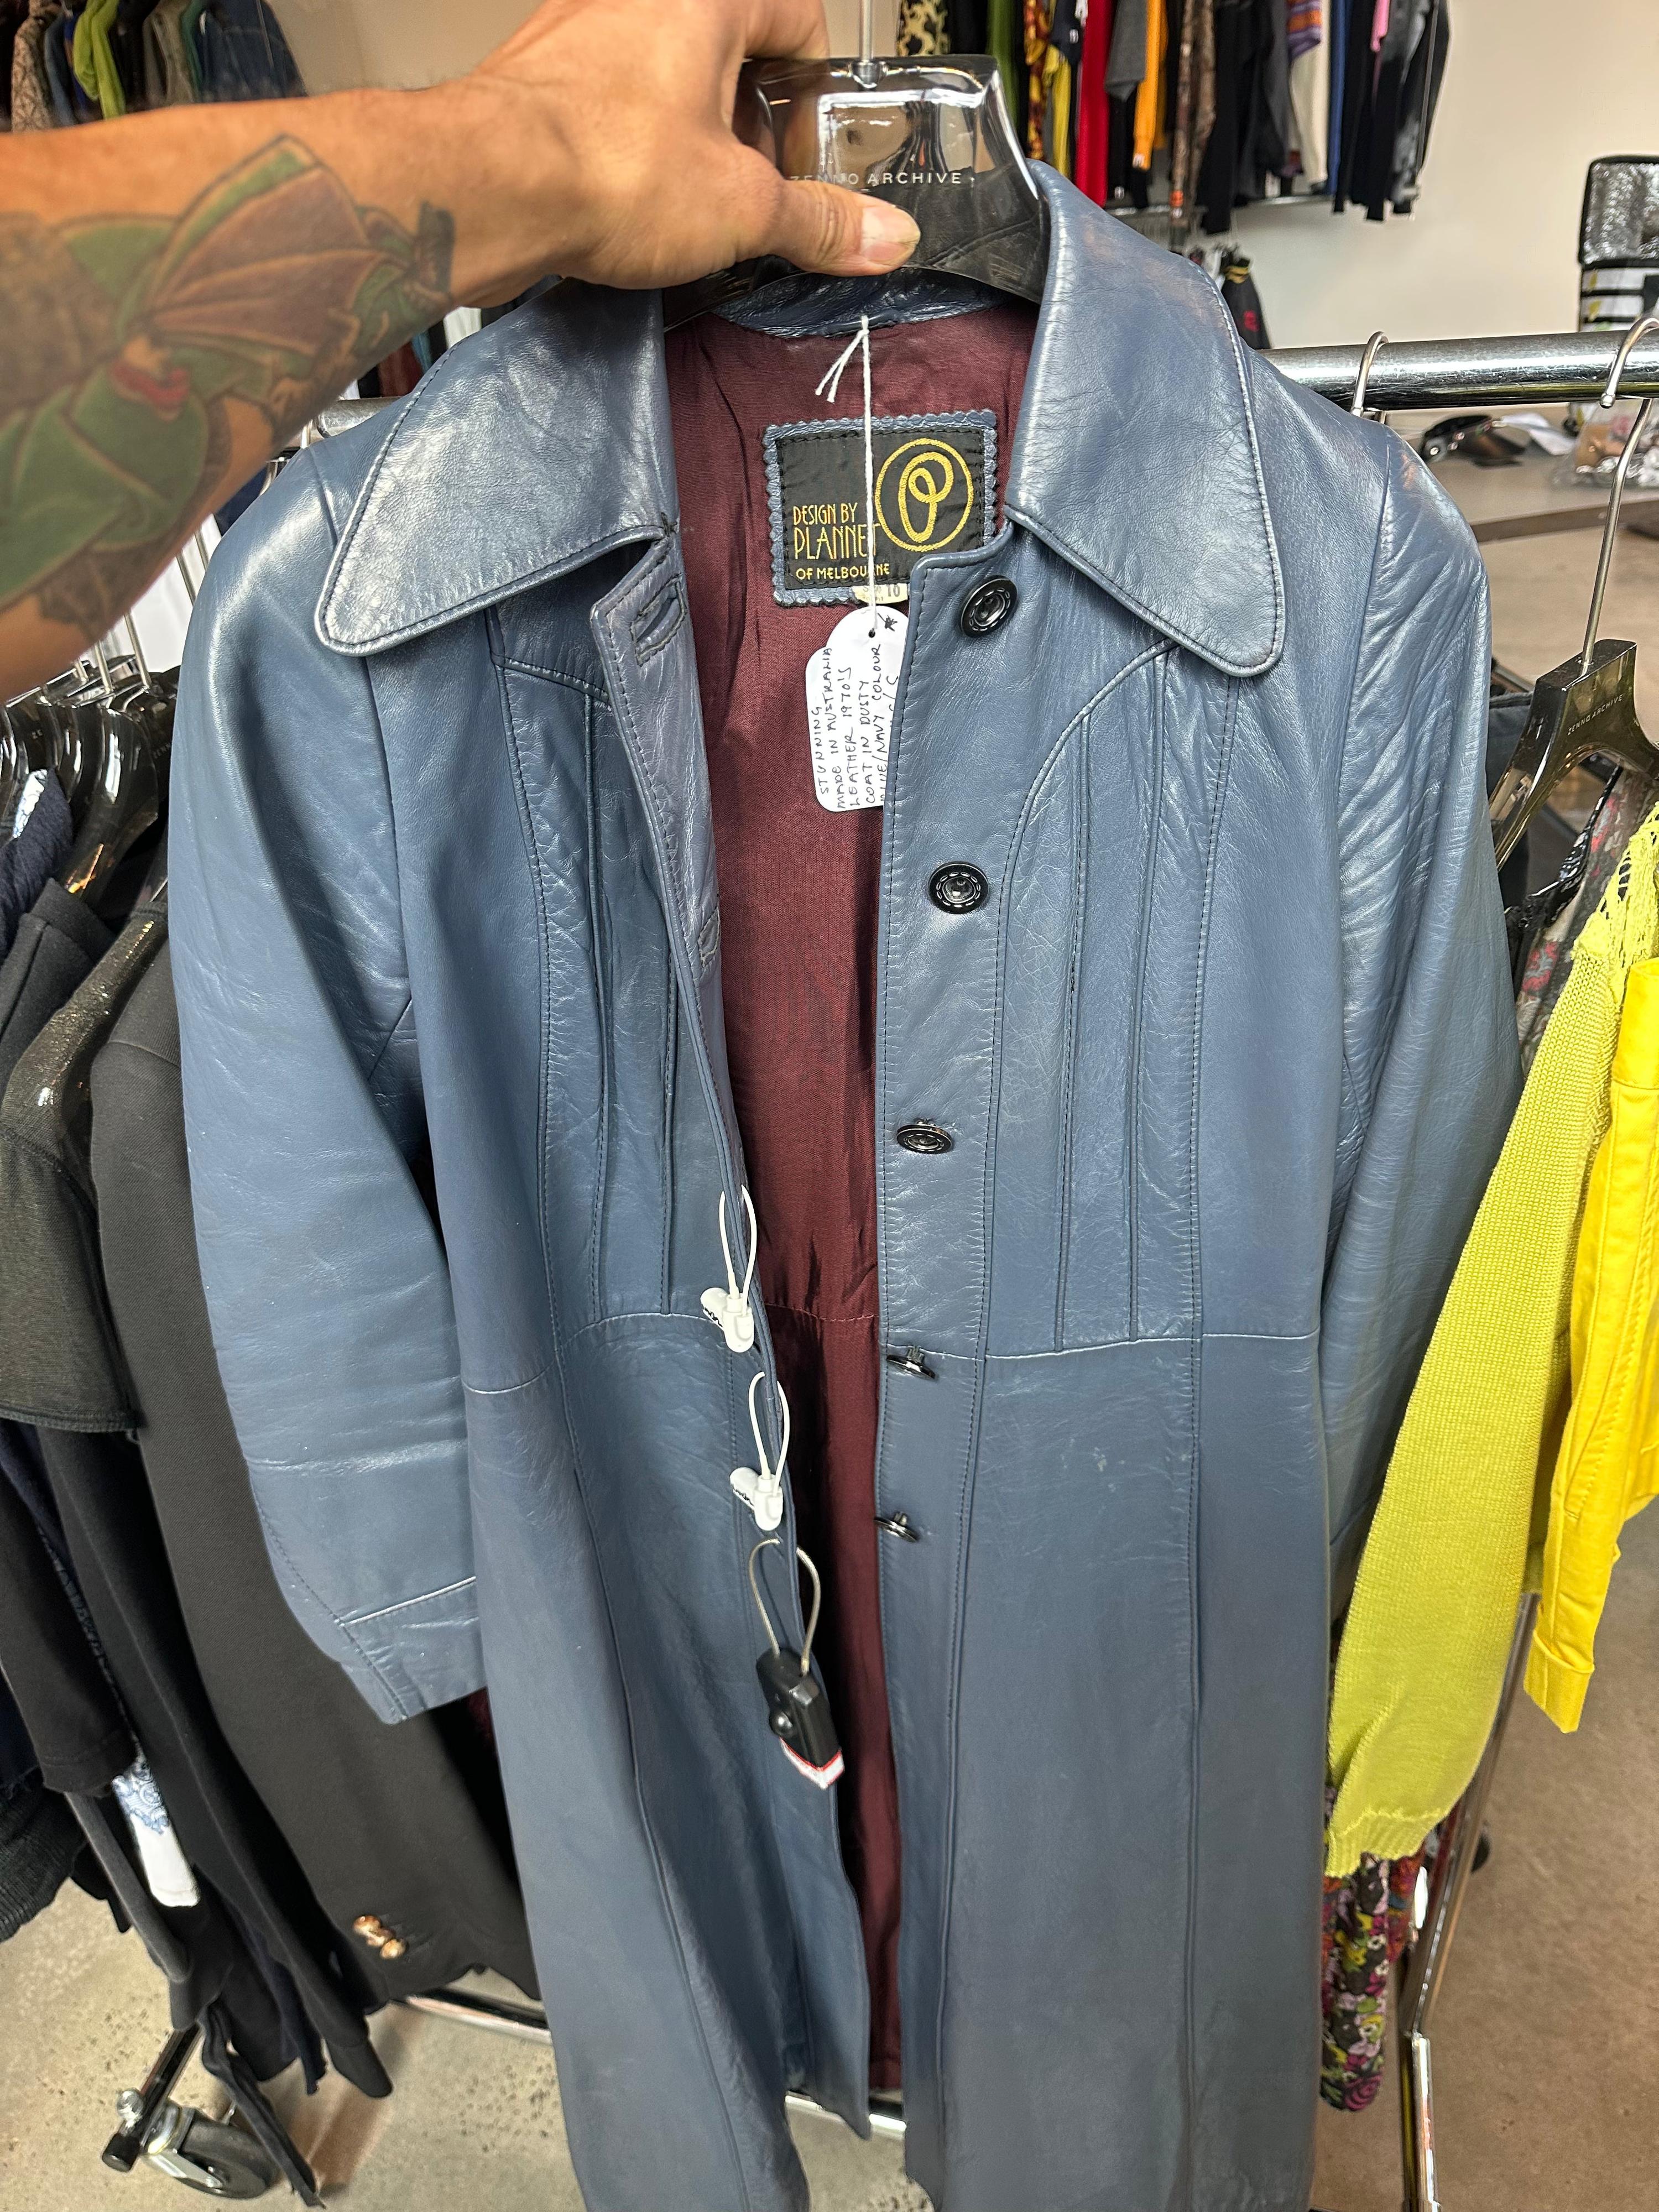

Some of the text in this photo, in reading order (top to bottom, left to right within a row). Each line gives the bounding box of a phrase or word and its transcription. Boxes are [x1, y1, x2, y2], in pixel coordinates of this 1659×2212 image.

[868, 172, 962, 185] ARCHIVE
[793, 502, 858, 526] DESIGN BY
[796, 563, 890, 580] OF MELBOUNE
[887, 585, 901, 597] 10
[871, 644, 882, 701] COLOUR
[822, 648, 846, 808] MADE IN AUSTRALIA
[837, 667, 860, 806] LEATHER 1970'S
[1567, 694, 1624, 736] ZENNO ARCHIVE
[811, 707, 829, 794] STUNNING
[858, 680, 875, 804] COAT IN DUSTY
